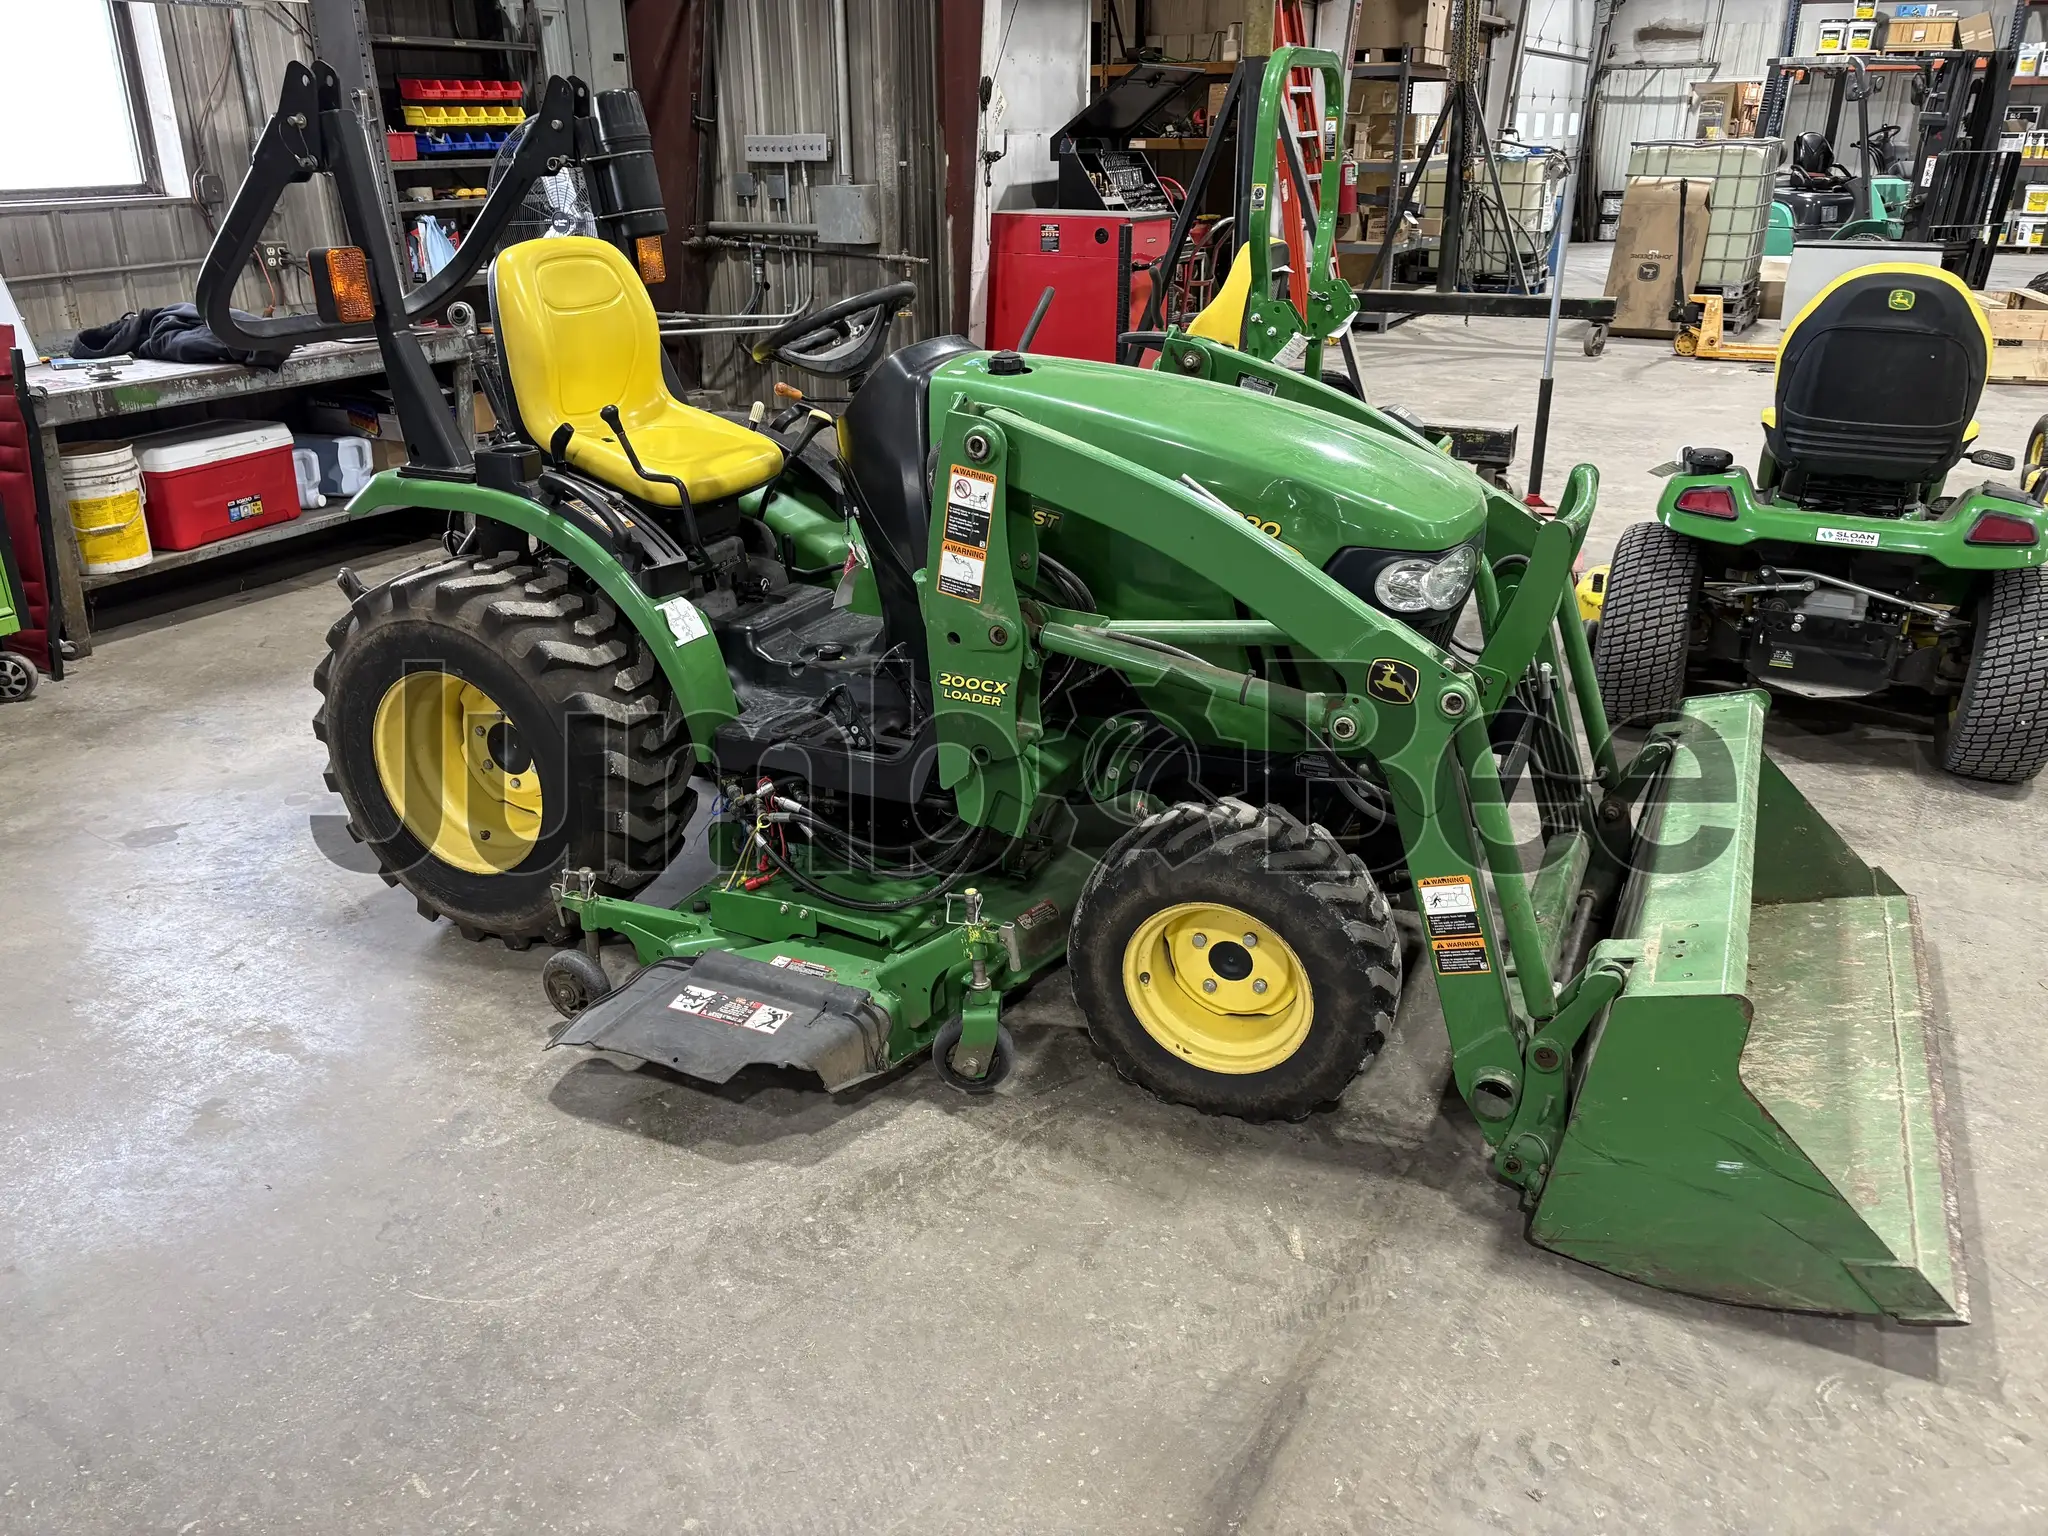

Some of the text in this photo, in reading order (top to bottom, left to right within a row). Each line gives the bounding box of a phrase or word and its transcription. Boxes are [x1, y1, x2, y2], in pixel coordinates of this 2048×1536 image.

[959, 467, 995, 483] WARNING
[1834, 537, 1875, 545] IMPLEMENT
[1836, 531, 1876, 541] SLOAN
[950, 544, 985, 560] WARNING
[939, 672, 1008, 695] 200CX
[943, 688, 1002, 707] LOADER
[1430, 876, 1465, 885] WARNING
[1445, 940, 1480, 949] WARNING
